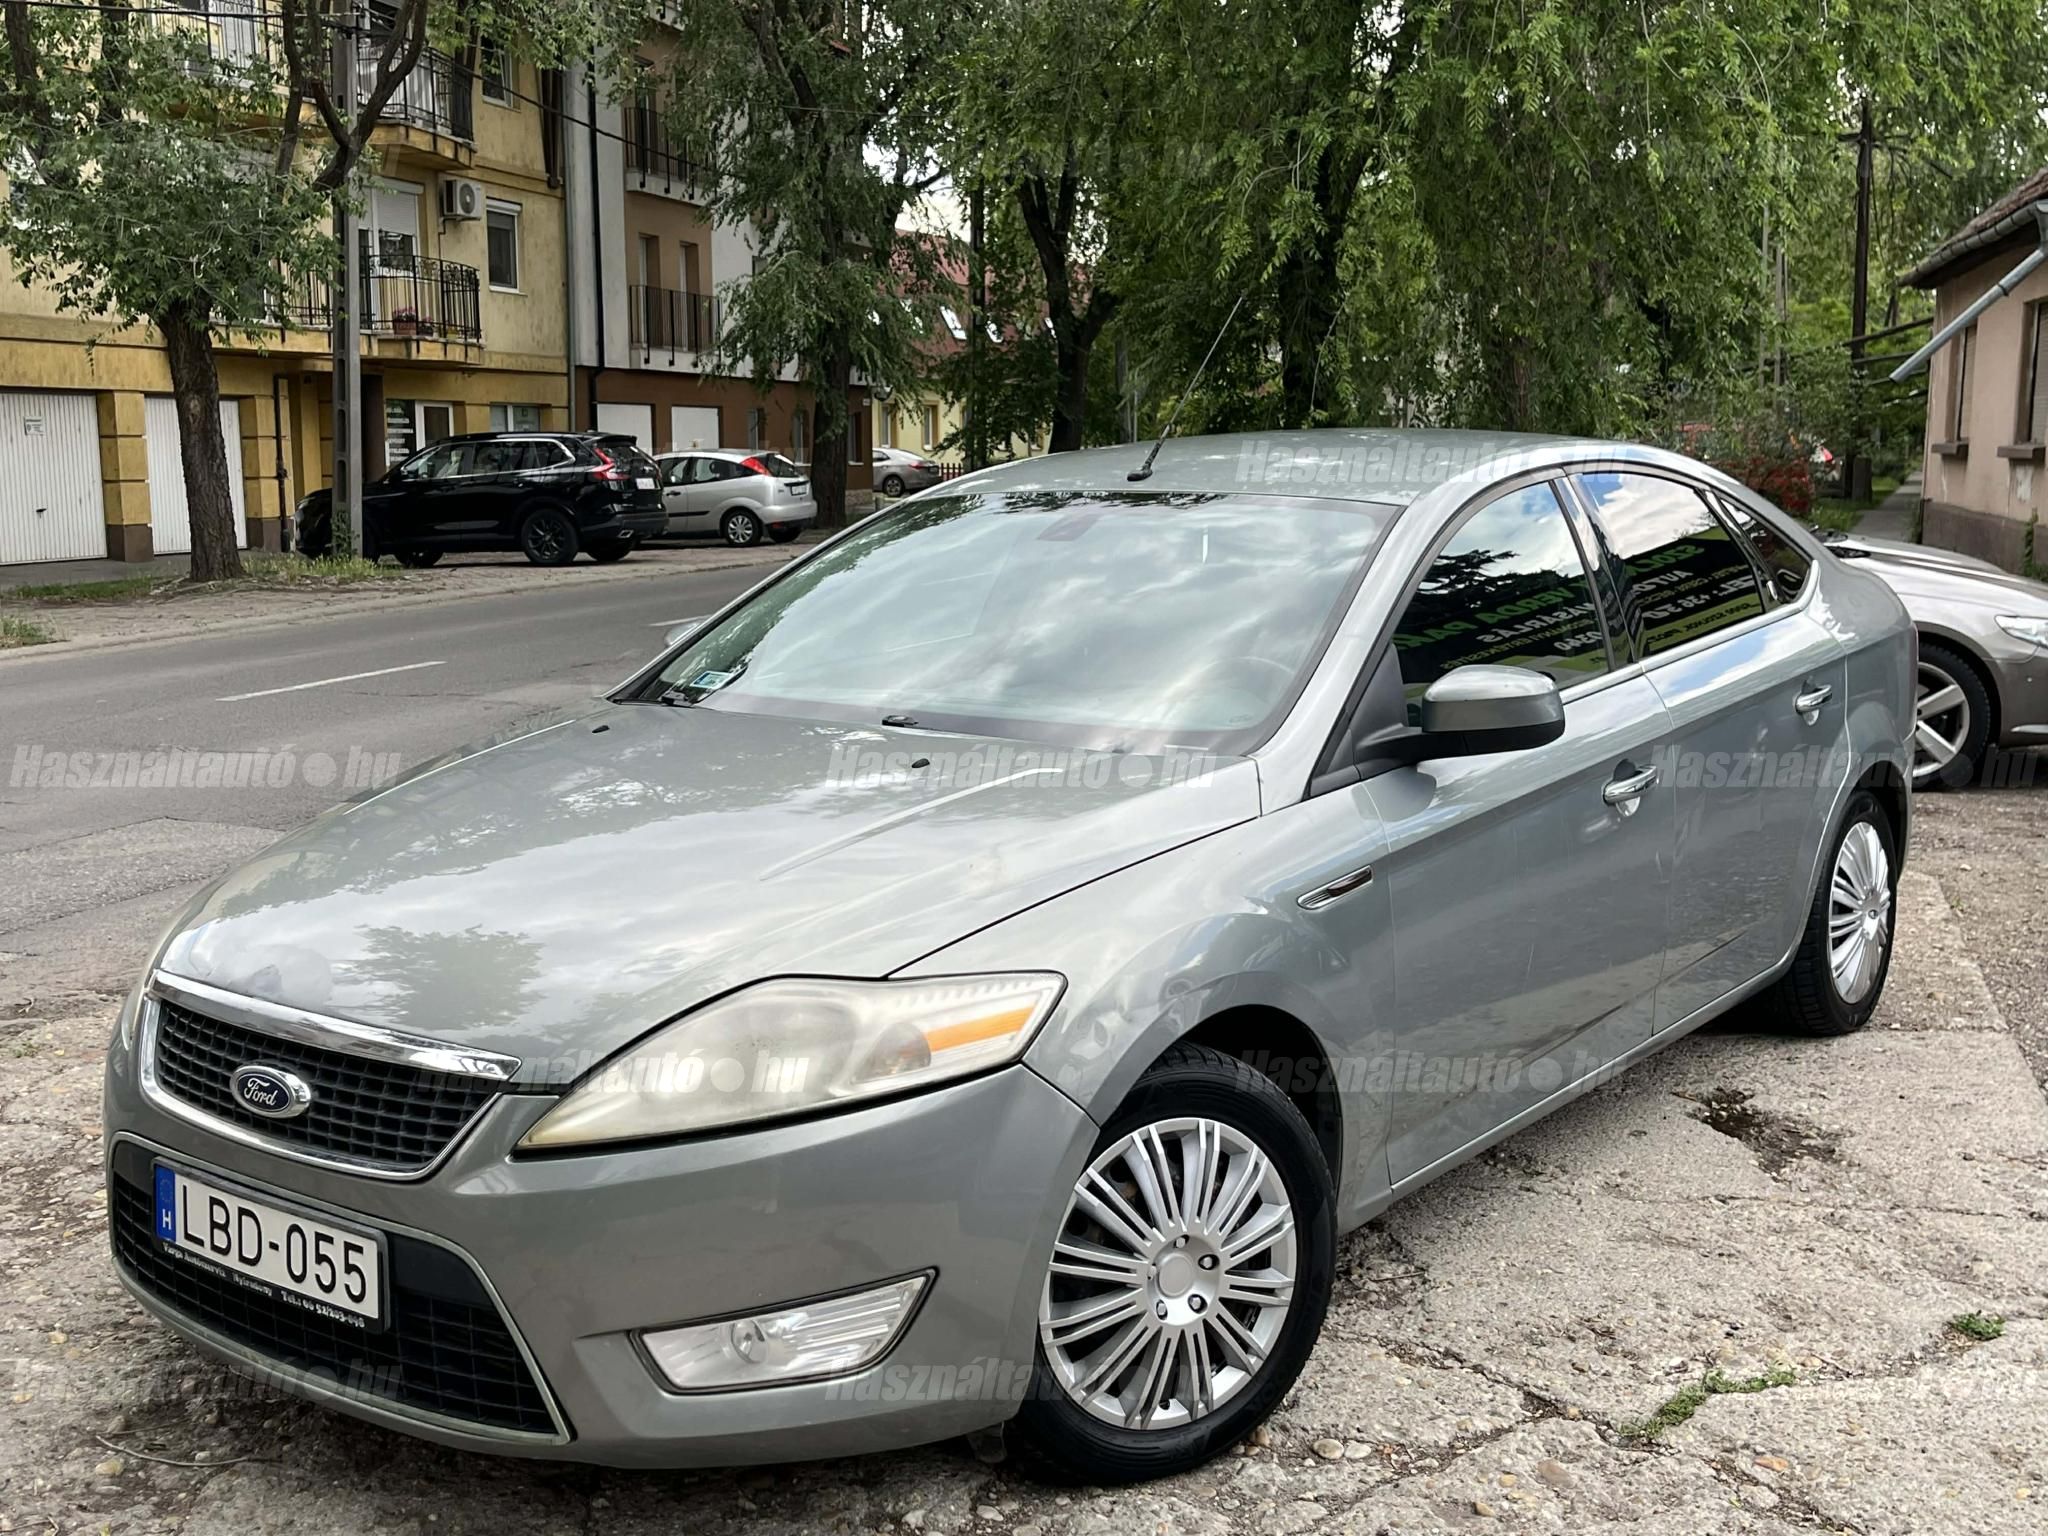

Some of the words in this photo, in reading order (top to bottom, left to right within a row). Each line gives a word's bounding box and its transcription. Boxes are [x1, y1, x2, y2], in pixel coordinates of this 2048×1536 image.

[243, 1077, 280, 1106] Ford
[162, 1208, 172, 1231] H
[182, 1183, 368, 1305] LBD-055
